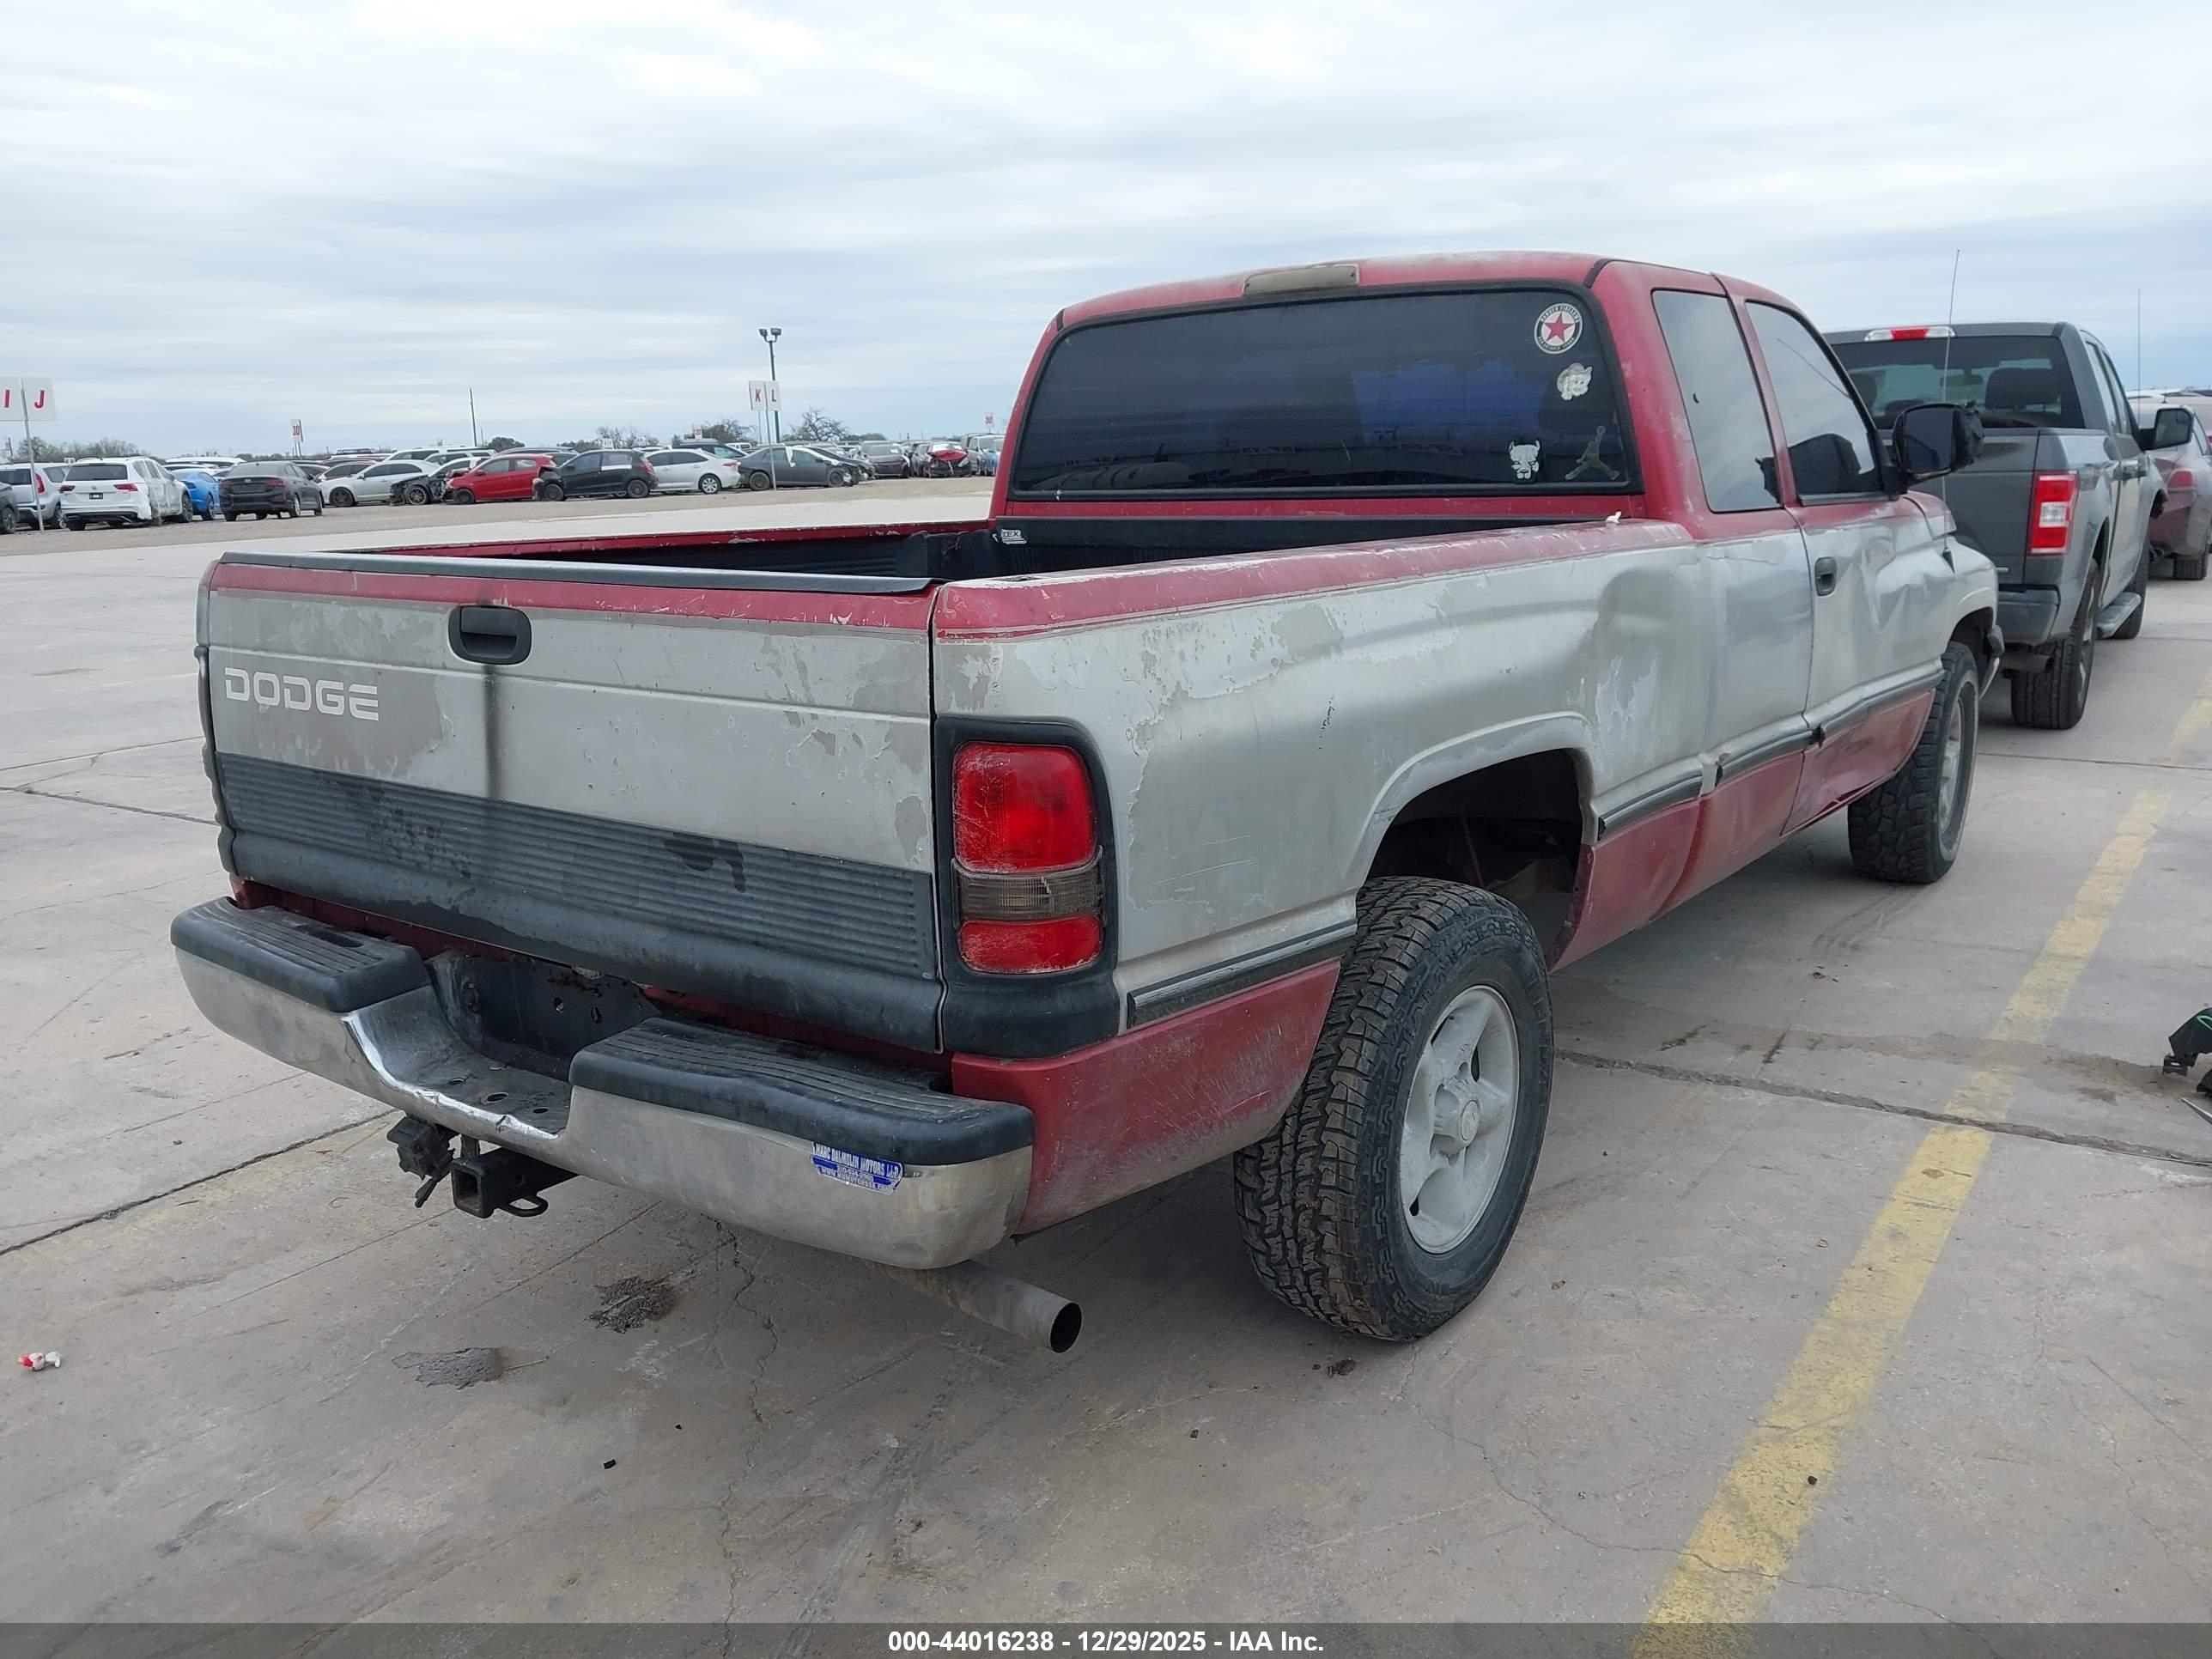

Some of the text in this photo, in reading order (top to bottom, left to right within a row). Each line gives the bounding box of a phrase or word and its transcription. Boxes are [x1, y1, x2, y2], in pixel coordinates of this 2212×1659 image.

[4, 389, 10, 408] I
[34, 390, 45, 408] J
[756, 389, 761, 402] K
[771, 389, 776, 402] L
[225, 667, 379, 721] DODGE
[816, 1143, 831, 1160] MARC
[860, 1157, 885, 1176] MOTORS
